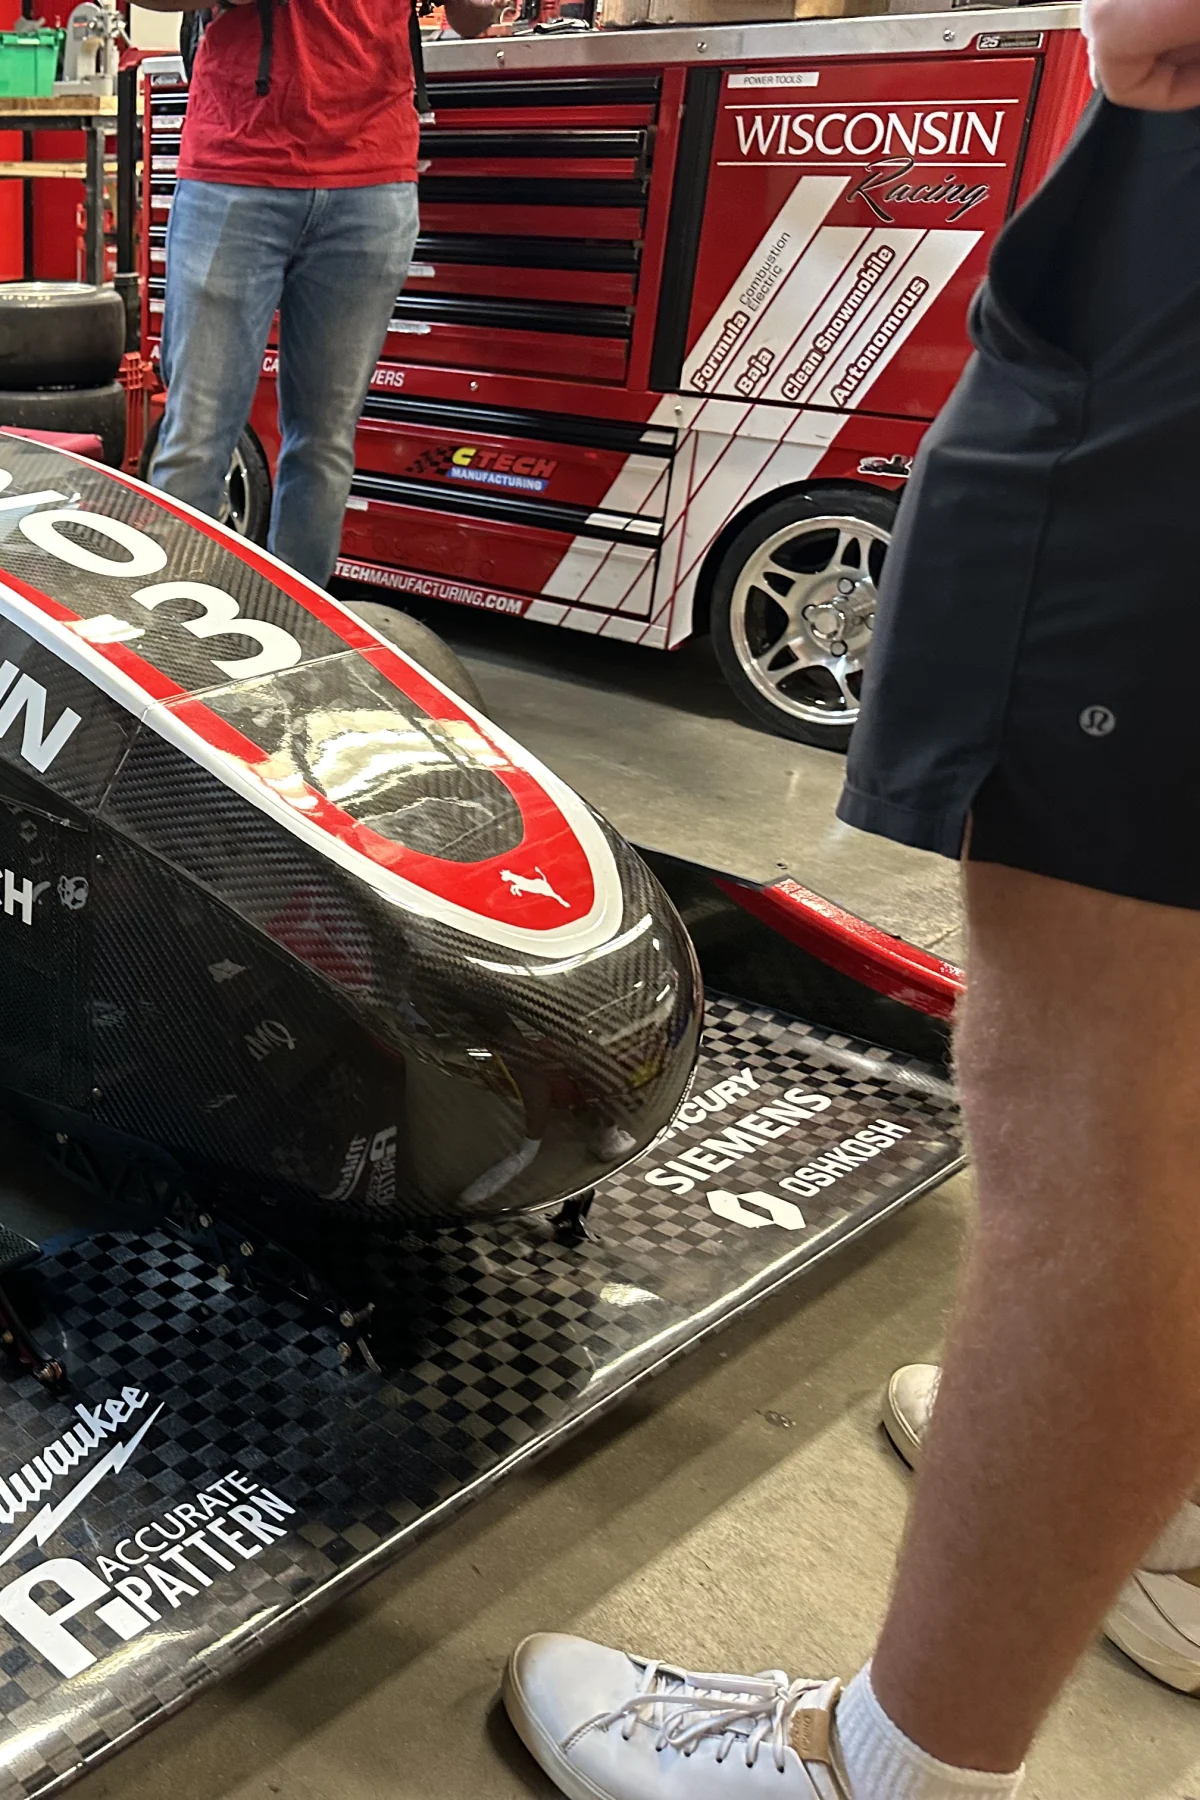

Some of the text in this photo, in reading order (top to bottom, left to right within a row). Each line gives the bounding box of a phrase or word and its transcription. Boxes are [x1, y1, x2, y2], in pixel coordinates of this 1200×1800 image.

[743, 74, 804, 85] POWER TOOLS
[736, 111, 1006, 156] WISCONSIN
[846, 156, 990, 222] Racing
[739, 231, 791, 306] Combustion
[748, 264, 783, 312] Electric
[691, 311, 749, 391] Formula
[781, 245, 895, 401] Clean Snowmobile
[830, 277, 929, 408] Autonomous
[736, 348, 775, 396] Baja
[450, 467, 542, 491] MANUFACTURING
[644, 1087, 832, 1195] SIEMENS
[778, 1118, 912, 1197] OSHKOSH
[96, 1470, 259, 1582] ACCURATE
[114, 1487, 296, 1622] PATTERN
